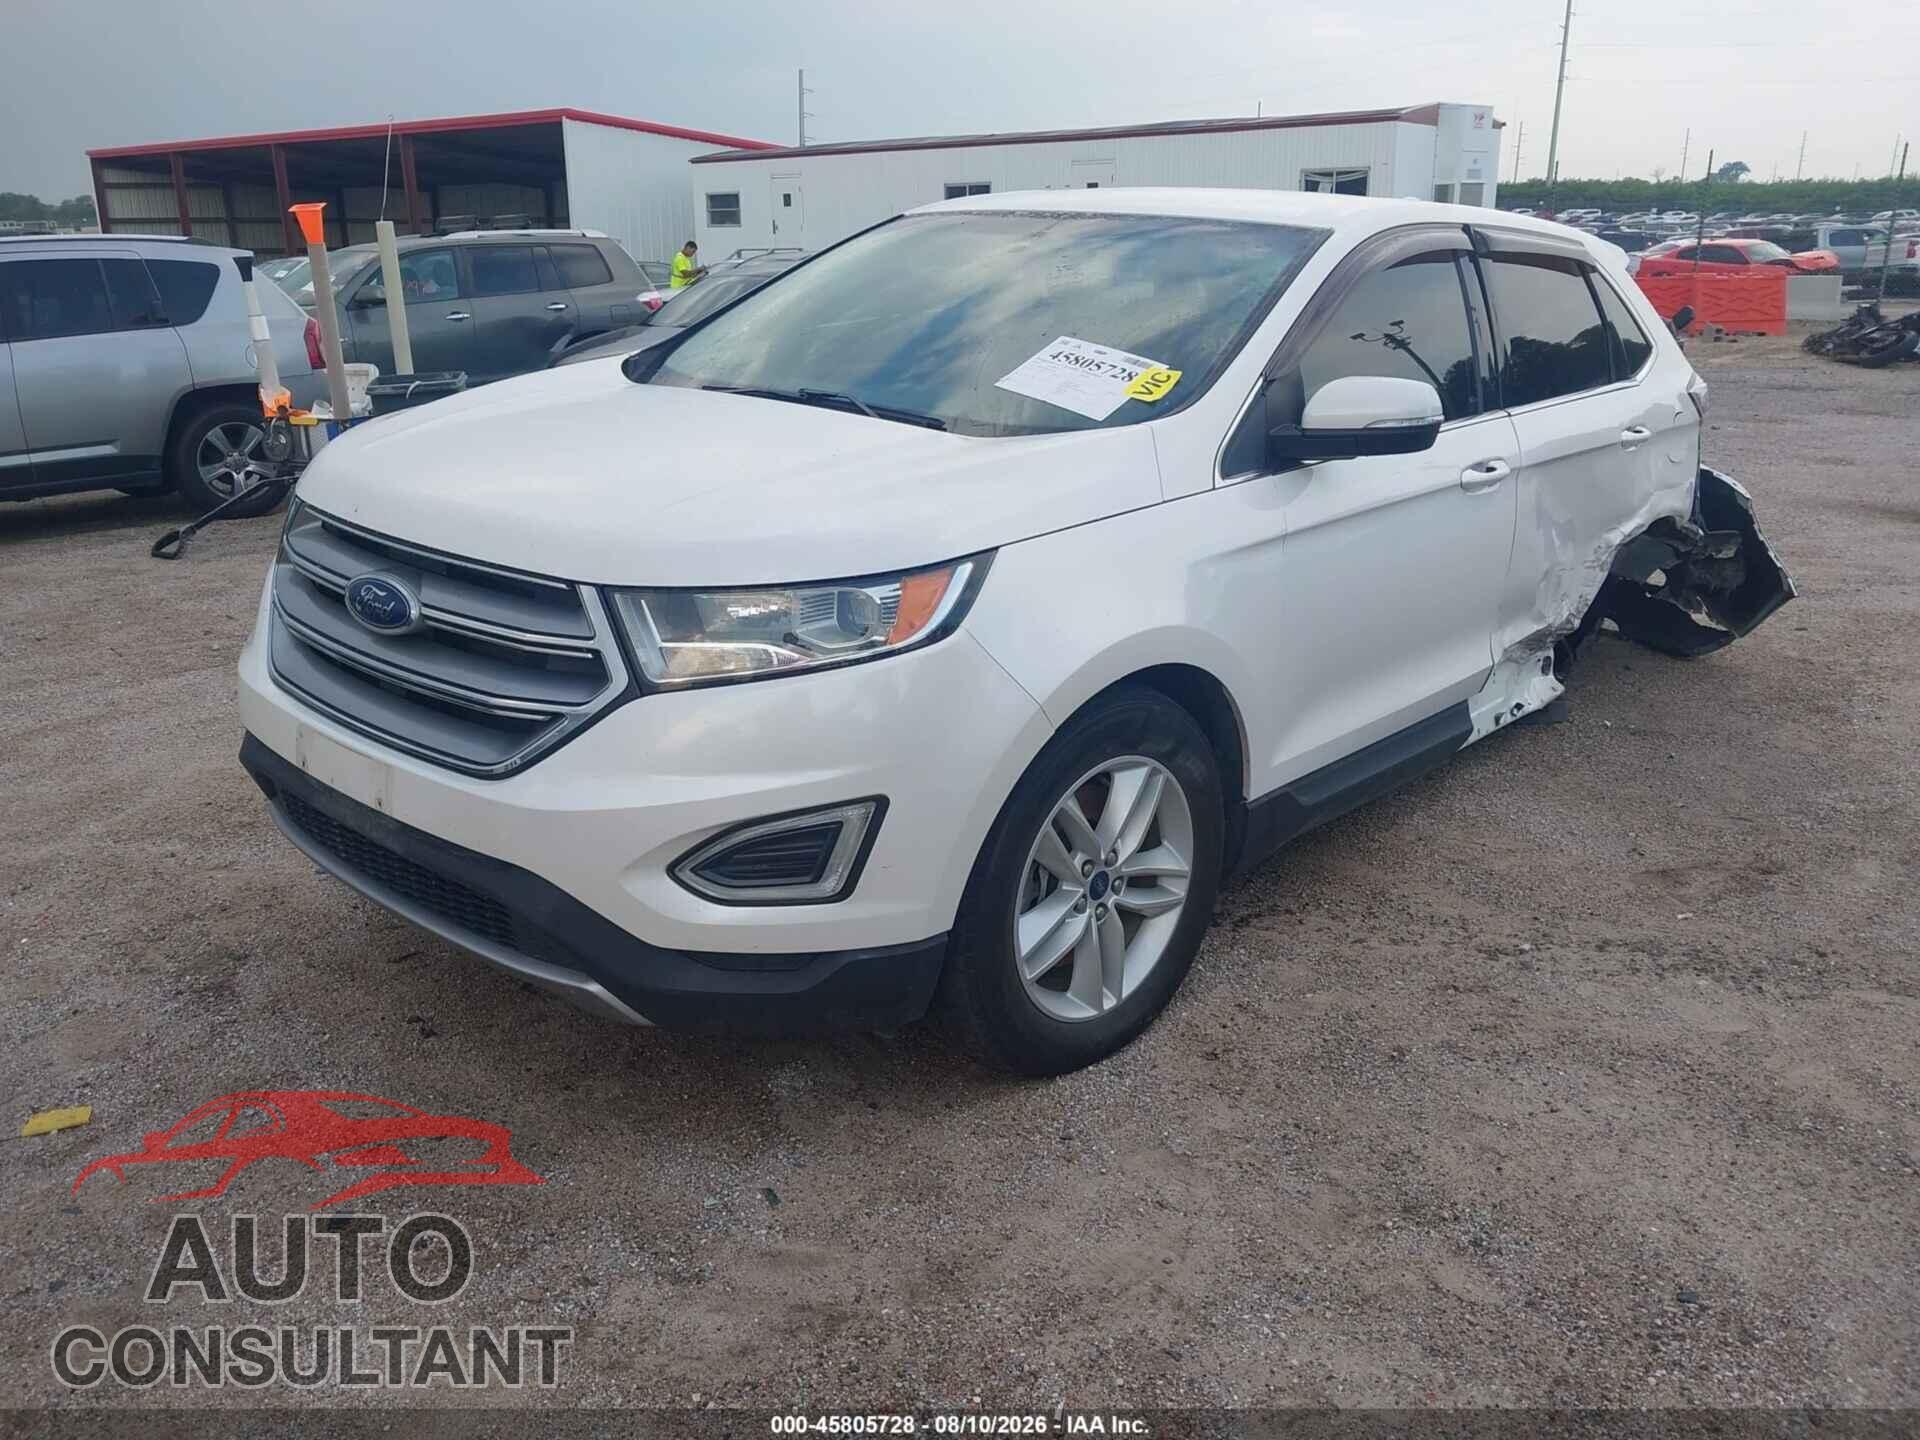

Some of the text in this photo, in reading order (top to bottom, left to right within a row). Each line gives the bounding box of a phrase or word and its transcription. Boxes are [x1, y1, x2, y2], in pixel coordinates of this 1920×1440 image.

[1049, 350, 1138, 382] 45805728
[1132, 371, 1171, 397] VIC
[355, 584, 396, 617] Ford
